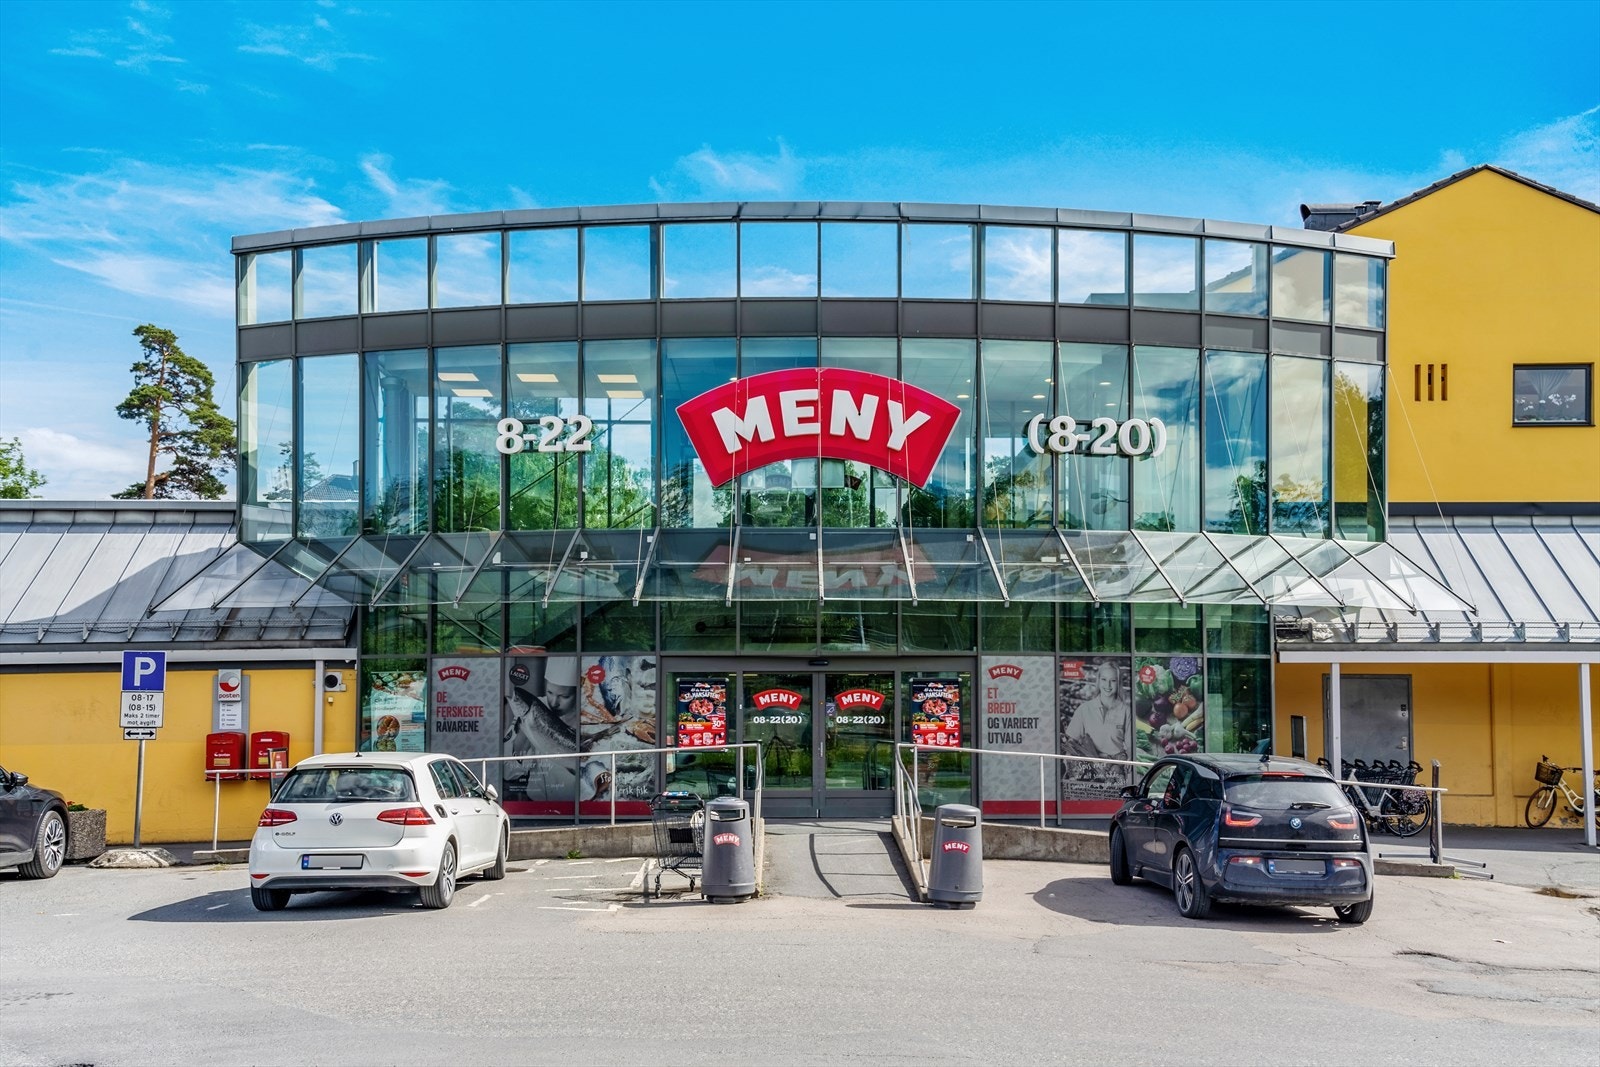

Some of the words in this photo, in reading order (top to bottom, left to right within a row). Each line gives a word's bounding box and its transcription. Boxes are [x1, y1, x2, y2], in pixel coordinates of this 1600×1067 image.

[711, 389, 931, 454] MENY
[496, 415, 593, 454] 8-22
[1028, 413, 1167, 457] (8-20)
[134, 657, 156, 686] P
[442, 669, 467, 678] MENY
[992, 667, 1019, 676] MENY
[436, 692, 447, 703] DE
[759, 692, 797, 705] MENY
[841, 692, 880, 705] MENY
[987, 688, 999, 699] ET
[436, 706, 484, 717] FERSKESTE
[987, 703, 1017, 714] BREDT
[436, 718, 479, 732] RÅVARENE
[753, 716, 802, 724] 08-22(20)
[836, 716, 885, 724] 08-22(20)
[987, 717, 1000, 729] OG
[1001, 717, 1039, 729] VARIERT
[987, 732, 1023, 744] UTVALG
[717, 834, 740, 843] MENY
[944, 843, 968, 851] MENY
